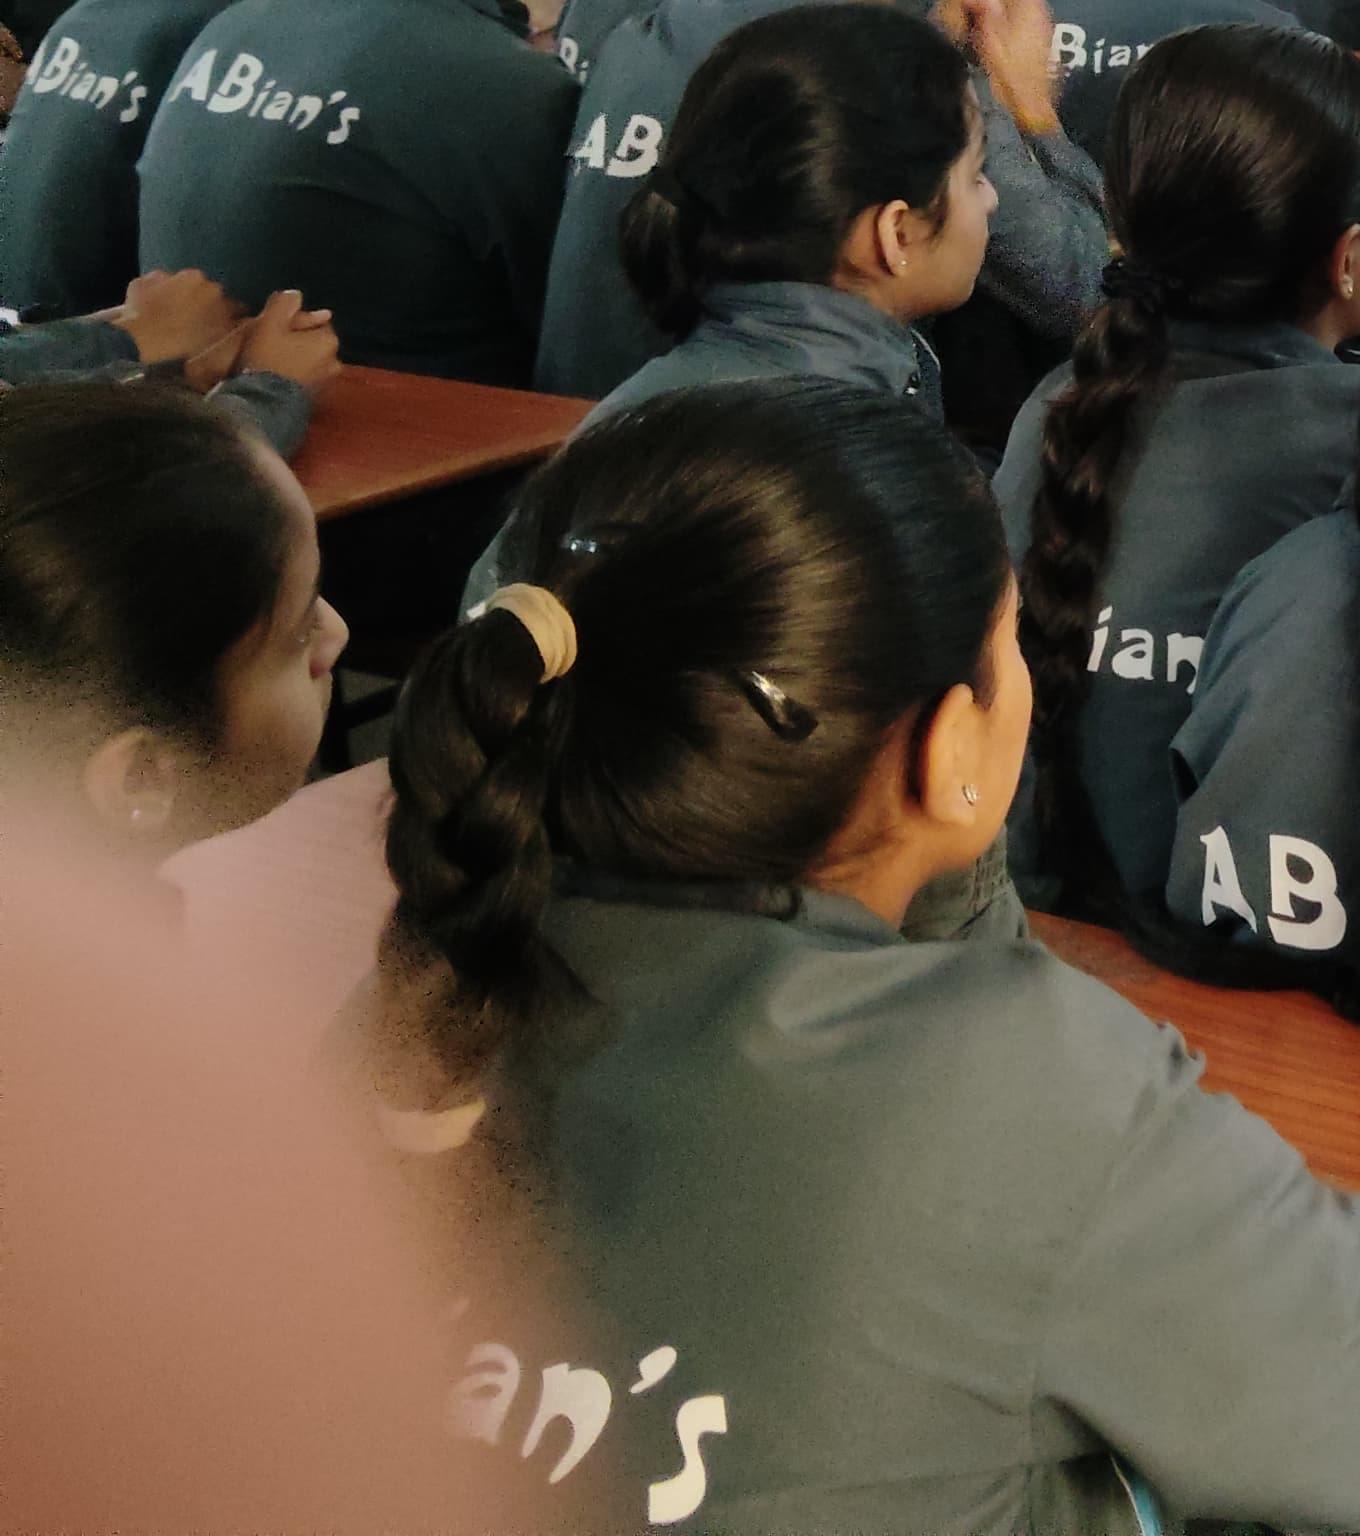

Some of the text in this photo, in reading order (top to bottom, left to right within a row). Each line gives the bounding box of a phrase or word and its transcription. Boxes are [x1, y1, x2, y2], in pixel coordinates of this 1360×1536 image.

[1047, 22, 1155, 77] Bia
[168, 48, 361, 146] ABian's
[572, 112, 663, 178] AB
[1086, 606, 1205, 695] ian
[446, 1340, 728, 1526] an's
